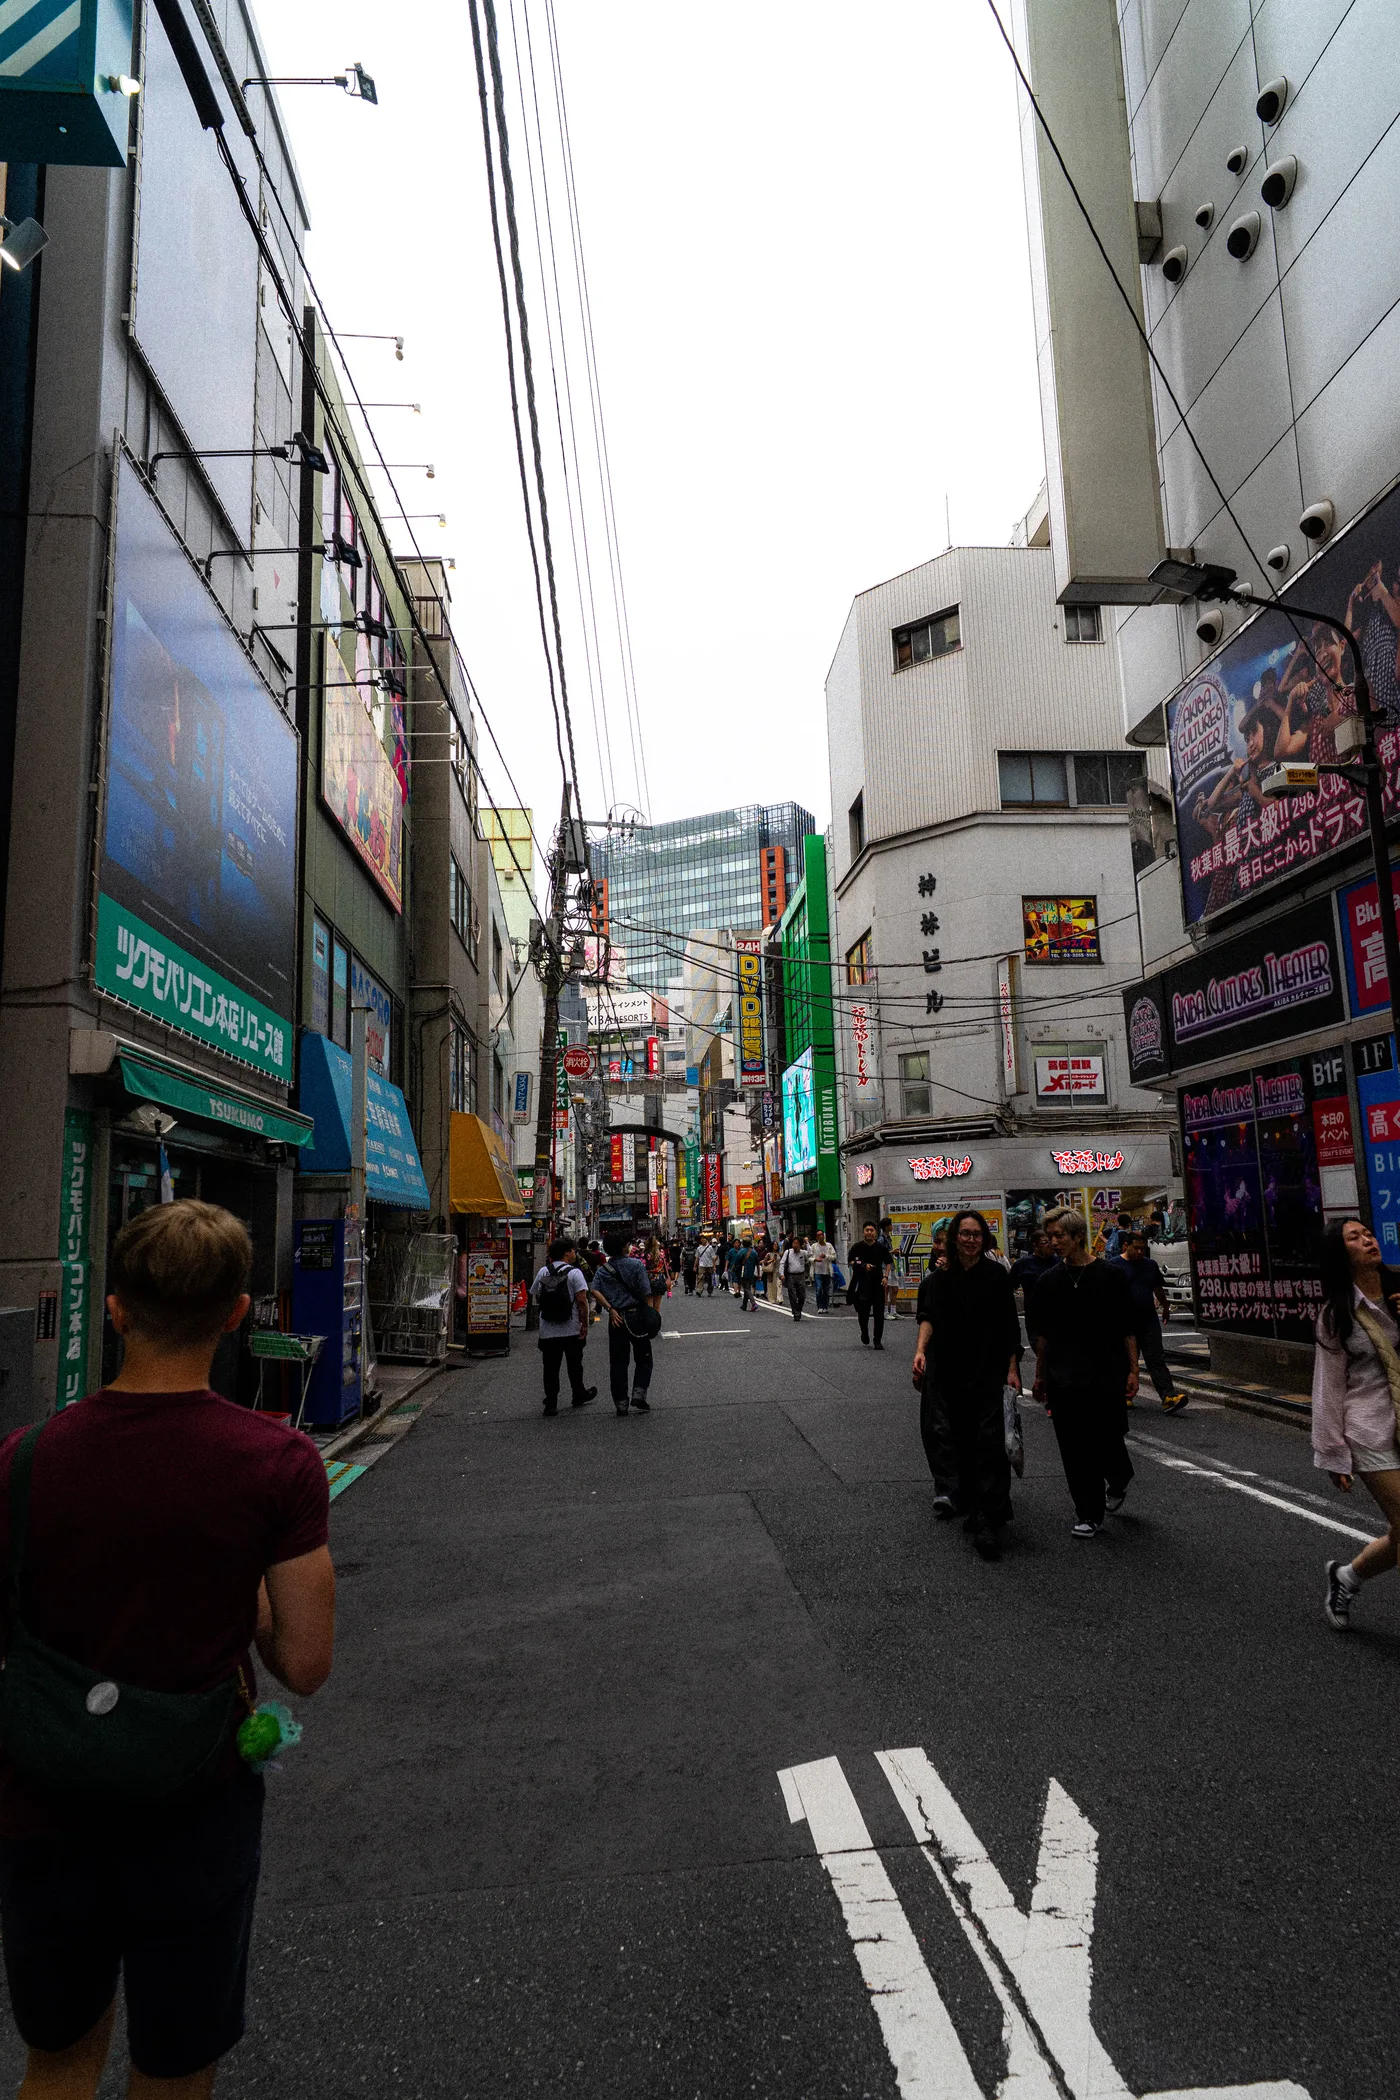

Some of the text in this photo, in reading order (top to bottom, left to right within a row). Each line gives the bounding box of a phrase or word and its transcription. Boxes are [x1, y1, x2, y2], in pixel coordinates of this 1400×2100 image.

[1183, 688, 1212, 726] AKIBA
[1178, 704, 1223, 753] CULTURES
[1182, 728, 1220, 772] THEATER
[737, 941, 761, 952] 24H
[918, 873, 943, 1014] 神林ビル
[1173, 941, 1329, 1028] AKIBA CULTURES THEATER
[851, 1005, 869, 1086] 福福トレカ
[1361, 1041, 1385, 1070] 1F
[565, 1057, 589, 1068] 消火栓
[1312, 1058, 1342, 1086] B1F
[1184, 1094, 1208, 1119] AKIBA
[1255, 1073, 1303, 1106] THEATER
[209, 1098, 264, 1131] TSUKUMO
[819, 1089, 836, 1154] KOTOBUKIYA
[1321, 1112, 1344, 1126] 本日の
[1320, 1127, 1349, 1143] イベント
[907, 1155, 974, 1180] 福福トレカ
[1050, 1149, 1125, 1175] 福福トレカ
[1092, 1190, 1122, 1210] 4F
[1197, 1254, 1260, 1276] 秋葉原最大級!!
